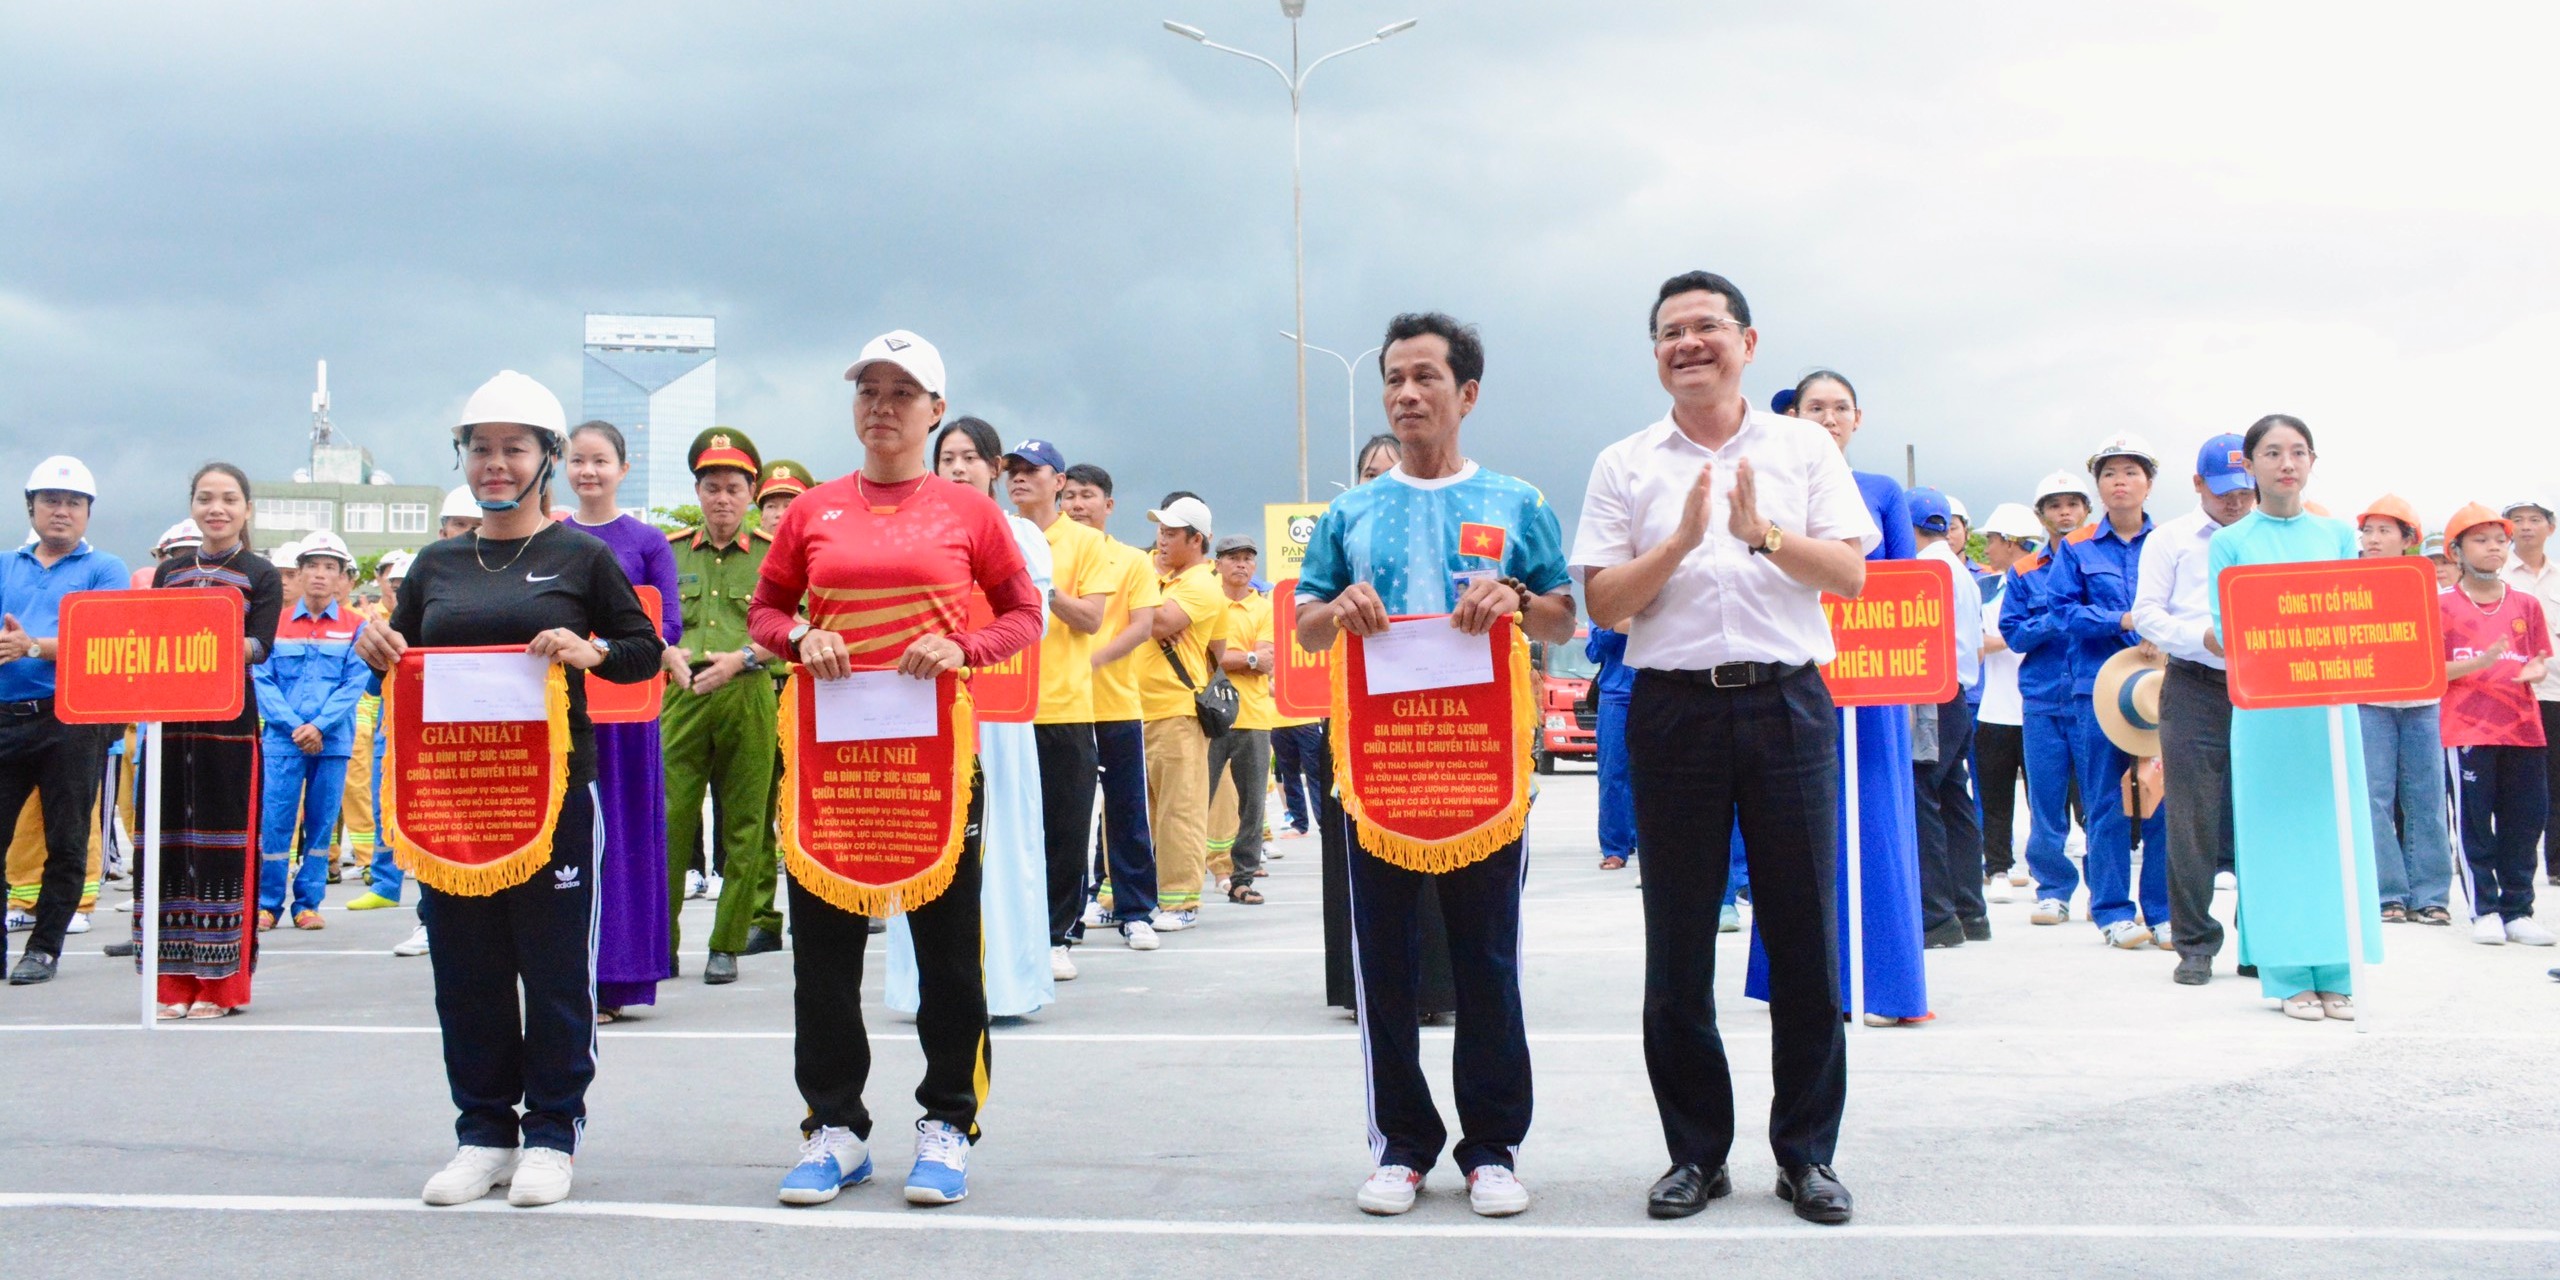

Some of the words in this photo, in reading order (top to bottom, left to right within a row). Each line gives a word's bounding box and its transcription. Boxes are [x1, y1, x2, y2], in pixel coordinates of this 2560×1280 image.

[1282, 546, 1306, 556] PAN
[1823, 603, 1835, 630] Y
[1842, 596, 1895, 630] XĂNG
[1901, 590, 1940, 628] DẦU
[2278, 591, 2307, 614] CÔNG
[2310, 593, 2322, 613] TY
[2326, 584, 2340, 611] CỔ
[2343, 584, 2373, 610] PHẦN
[2245, 627, 2267, 656] VẬN
[2269, 623, 2285, 648] TẢI
[2289, 625, 2302, 648] VÀ
[2306, 628, 2330, 652] DỊCH
[2334, 627, 2347, 651] VỤ
[2350, 621, 2417, 644] PETROLIMEX
[86, 629, 150, 683] HUYỆN
[156, 637, 169, 673] A
[175, 627, 217, 673] LƯỚI
[1890, 639, 1927, 676] HUẾ
[2289, 656, 2318, 682] THỪA
[2320, 654, 2351, 680] THIÊN
[2354, 653, 2375, 679] HUẾ
[1393, 693, 1437, 717] GIẢI
[1441, 698, 1469, 716] BA
[422, 722, 465, 745] GIẢI
[1375, 725, 1389, 736] GIA
[1392, 722, 1413, 735] ĐÌNH
[1416, 721, 1434, 735] TIẾP
[1437, 721, 1455, 734] SỨC
[1458, 724, 1488, 734] 4X50M
[419, 752, 433, 763] GIA
[436, 750, 457, 762] ĐÌNH
[460, 748, 477, 761] TIẾP
[480, 749, 497, 761] SỨC
[500, 749, 528, 760] 4X50M
[837, 741, 879, 763] GIẢI
[884, 743, 918, 764] NHÌ
[1364, 740, 1387, 753] CHỮA
[1389, 738, 1413, 753] CHÁY,
[1416, 742, 1425, 752] DI
[1428, 736, 1463, 752] CHUYỂN
[1465, 738, 1478, 752] TÀI
[1482, 737, 1500, 752] SẢN
[407, 767, 431, 780] CHỮA
[434, 767, 457, 780] CHÁY,
[460, 768, 468, 778] DI
[471, 763, 504, 778] CHUYỂN
[507, 764, 520, 777] TÀI
[522, 762, 538, 776] SẢN
[824, 771, 838, 782] GIA
[840, 768, 861, 782] ĐÌNH
[864, 768, 880, 782] TIẾP
[883, 769, 900, 783] SỨC
[902, 772, 930, 783] 4X50M
[812, 785, 835, 799] CHỮA
[838, 785, 861, 799] CHÁY,
[864, 788, 872, 798] DI
[875, 784, 906, 799] CHUYỂN
[909, 787, 920, 800] TÀI
[923, 786, 941, 801] SẢN
[554, 881, 580, 889] adidas
